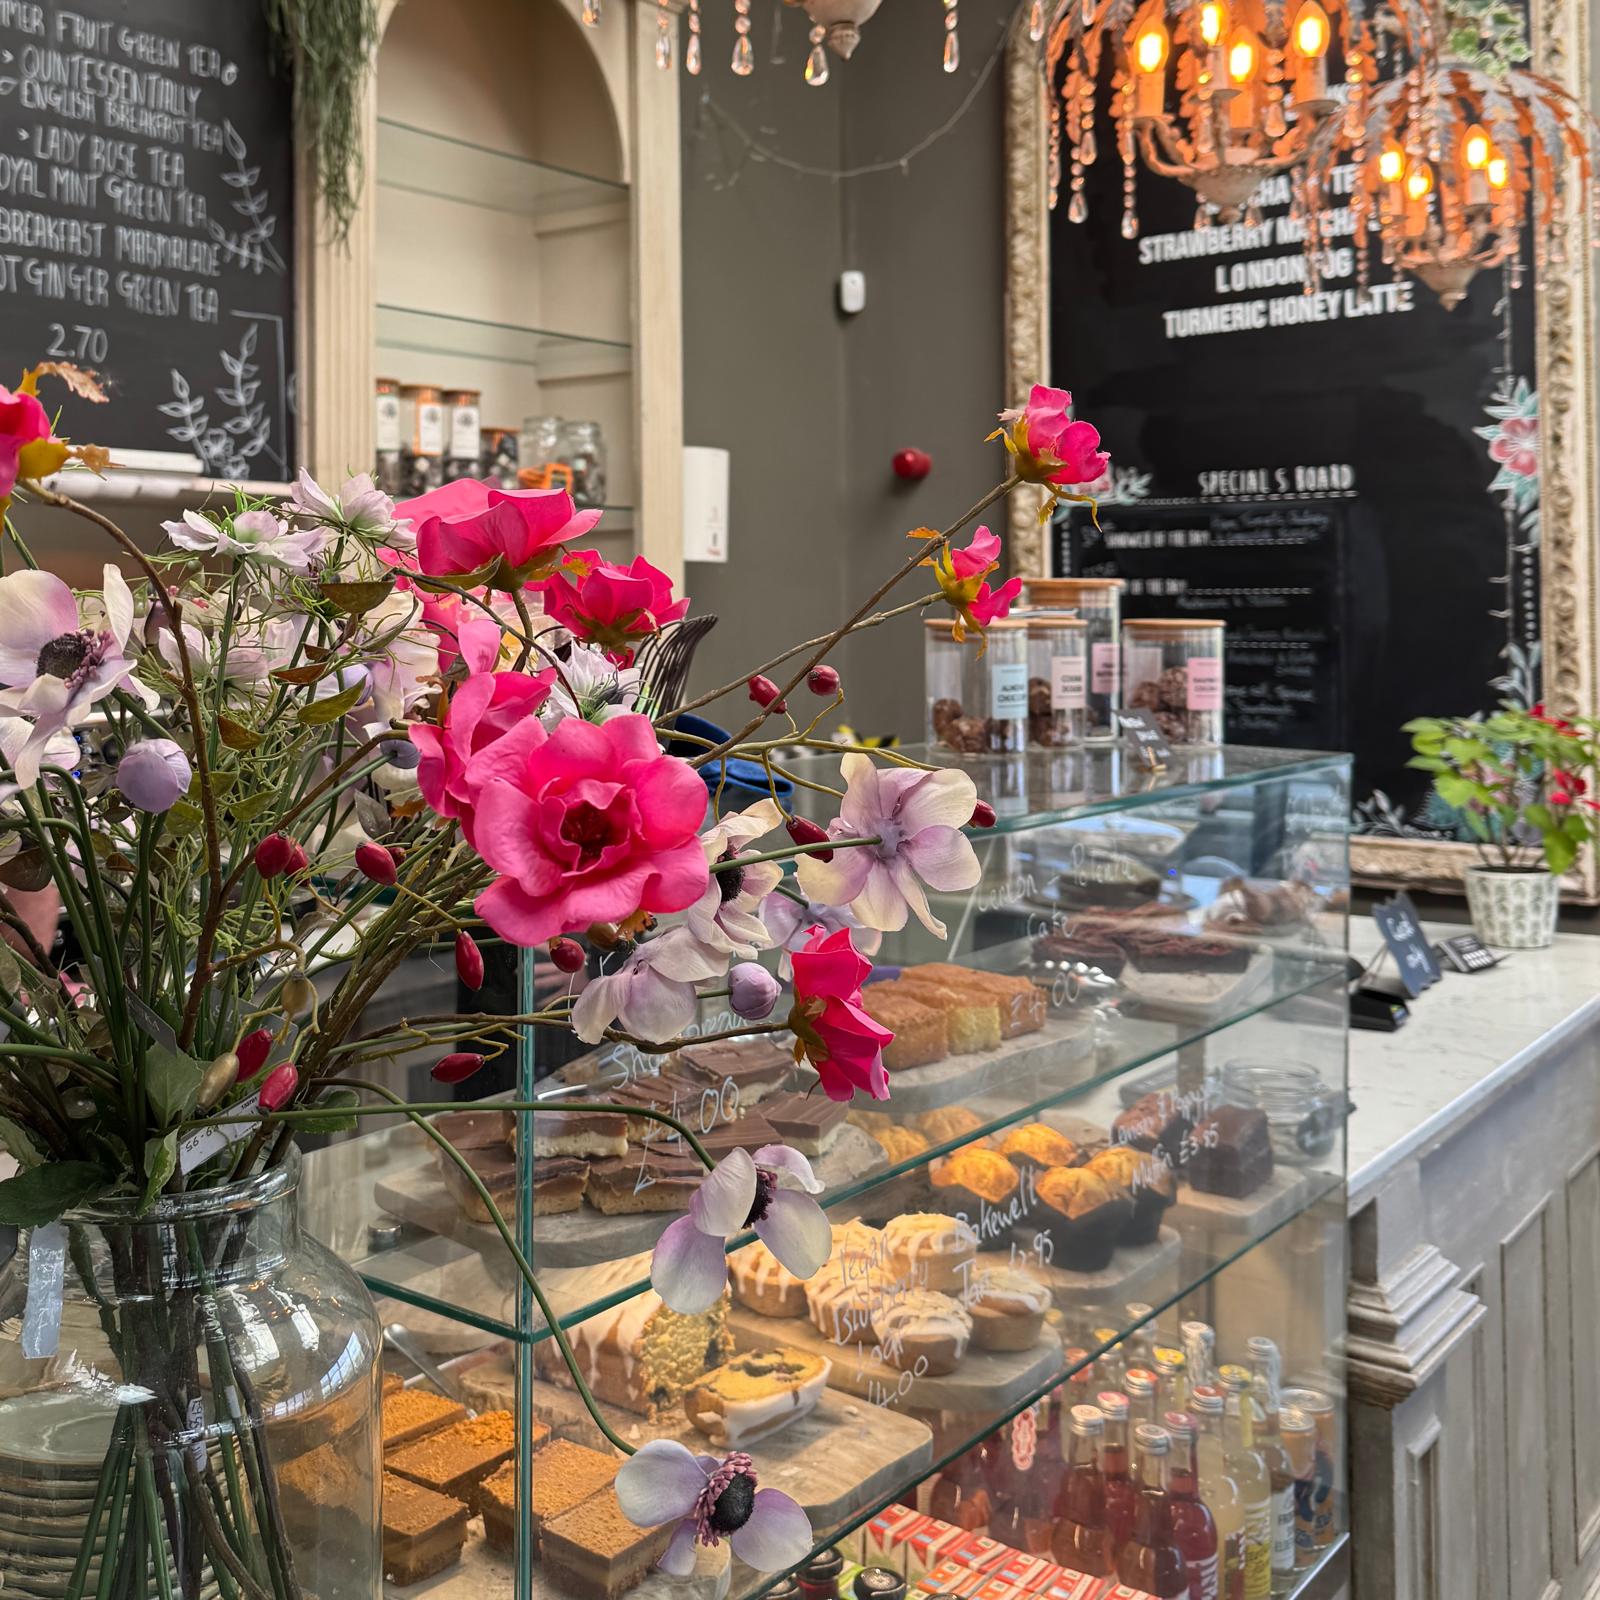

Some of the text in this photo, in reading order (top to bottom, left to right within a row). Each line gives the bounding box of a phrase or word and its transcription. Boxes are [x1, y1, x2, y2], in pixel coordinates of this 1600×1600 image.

[56, 10, 114, 54] FRUIT
[117, 25, 181, 69] GREEN
[189, 45, 222, 79] TEA
[20, 78, 223, 154] ENGLISH BREAKFAST TEA
[34, 125, 86, 167] LADY
[147, 146, 185, 188] TEA
[51, 165, 102, 209] MINT
[104, 174, 172, 225] GREEN
[175, 187, 207, 230] TEA
[0, 206, 221, 277] BREAKFAST MARMALADE
[1138, 216, 1275, 265] STRAWBERRY
[1275, 205, 1357, 246] MACHA
[23, 257, 109, 308] GINGER
[115, 270, 181, 317] GREEN
[185, 283, 219, 323] TEA
[1215, 247, 1352, 293] LONDON OG
[1162, 281, 1415, 338] TURMERIC HONEY LATTE
[48, 322, 108, 363] 2.70
[1027, 902, 1079, 940] Cake
